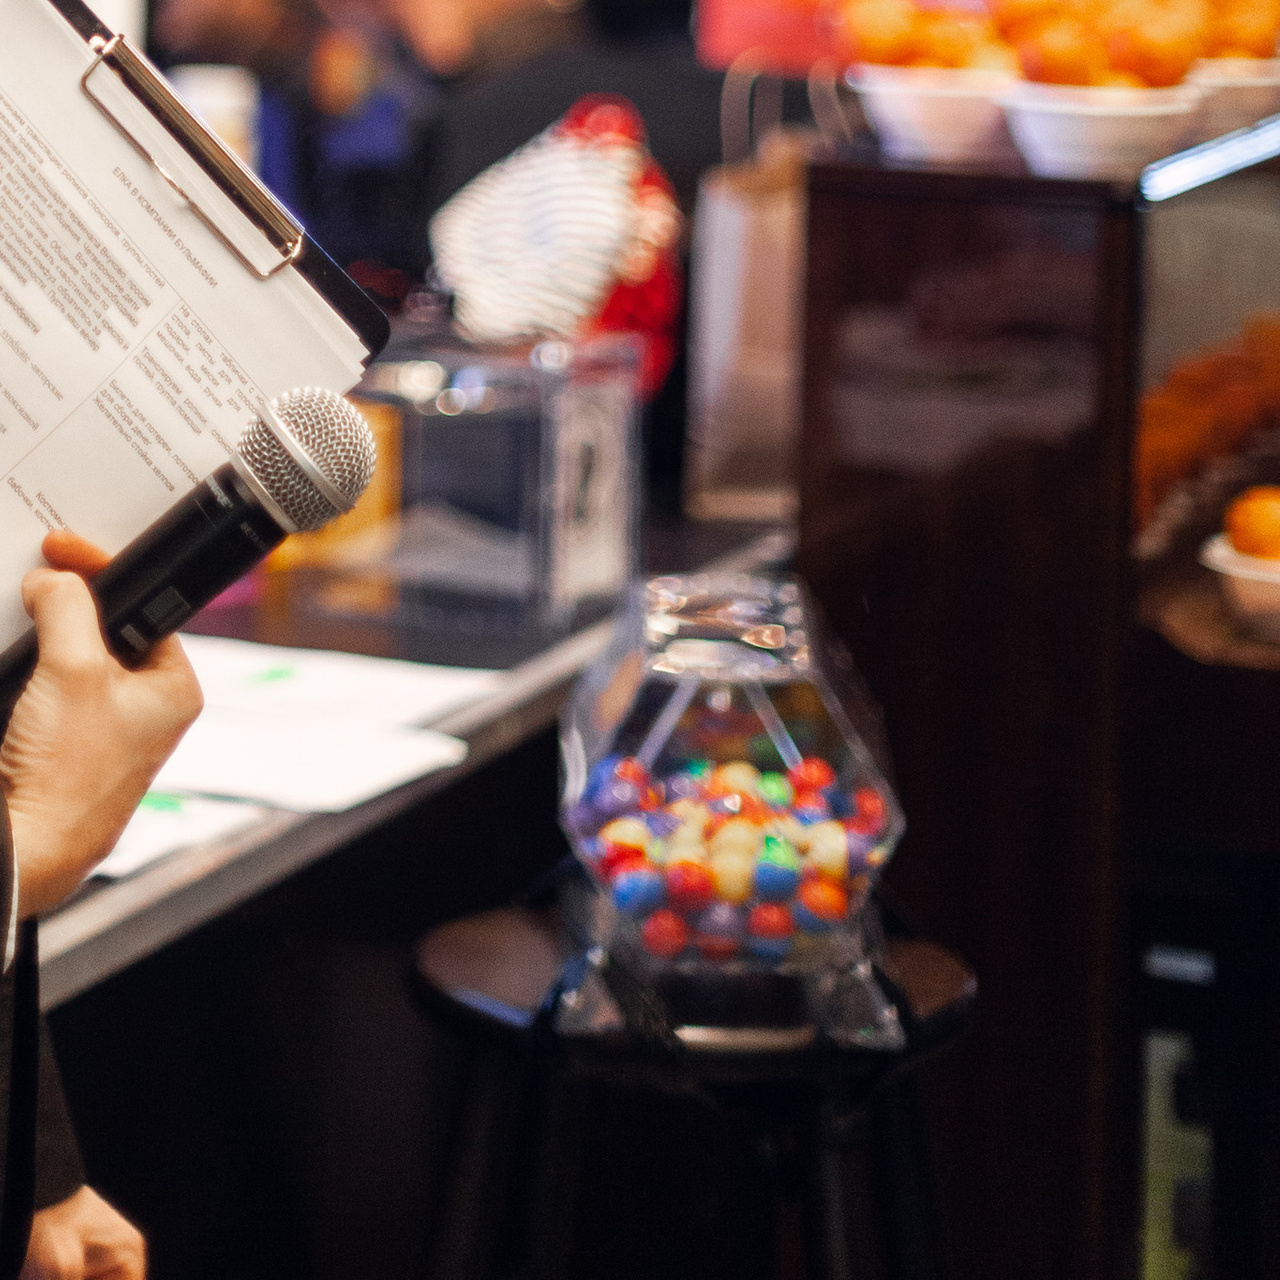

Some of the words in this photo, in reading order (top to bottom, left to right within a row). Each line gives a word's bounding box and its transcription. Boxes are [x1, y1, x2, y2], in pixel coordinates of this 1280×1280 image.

[112, 167, 132, 189] ЕЛКА
[136, 194, 176, 240] КОМПАНИИ
[173, 238, 217, 288] БУЛЬМАФИИ
